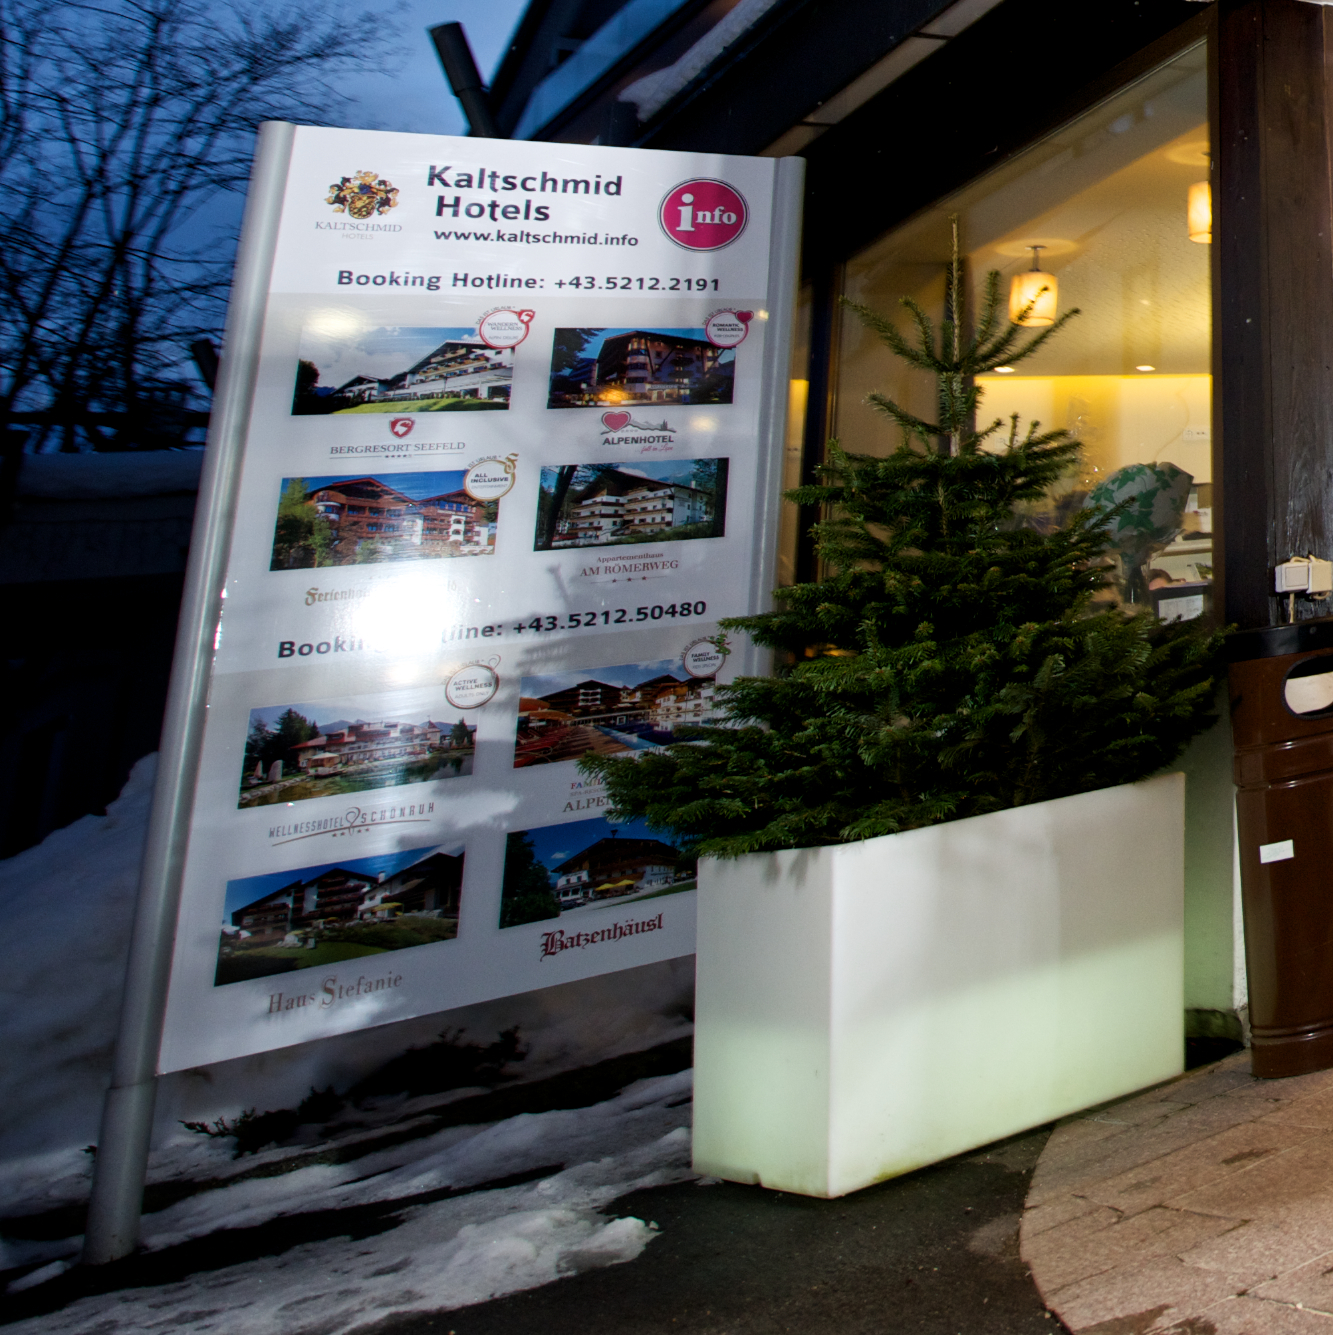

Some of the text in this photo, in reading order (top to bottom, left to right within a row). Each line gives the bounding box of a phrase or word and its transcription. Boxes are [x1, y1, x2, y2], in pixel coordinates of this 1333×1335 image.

[427, 165, 622, 196] Kaltschmid
[435, 195, 550, 222] Hotels
[676, 193, 738, 232] info
[315, 221, 402, 233] KALTSCHMID
[341, 232, 374, 241] HOTELS
[434, 229, 639, 247] www.kaltschmid.info
[337, 270, 720, 292] Booking Hotline: +43.5212.2191
[330, 442, 466, 455] BERGRESORT SEEFELD
[602, 434, 675, 446] ALPENHOTEL
[470, 476, 509, 484] INCLUSIVE
[596, 552, 664, 564] Appartementhaus
[580, 559, 679, 577] AM RÖMERWEG
[278, 635, 389, 658] Booki
[513, 601, 707, 634] +43.5212.50480
[453, 678, 478, 686] ACTIVE
[455, 681, 493, 691] WELLNESS
[268, 816, 345, 838] WELLNESSHOTEL
[540, 912, 664, 962] Batzenhäusl
[267, 970, 403, 1015] Haus Stefanie
